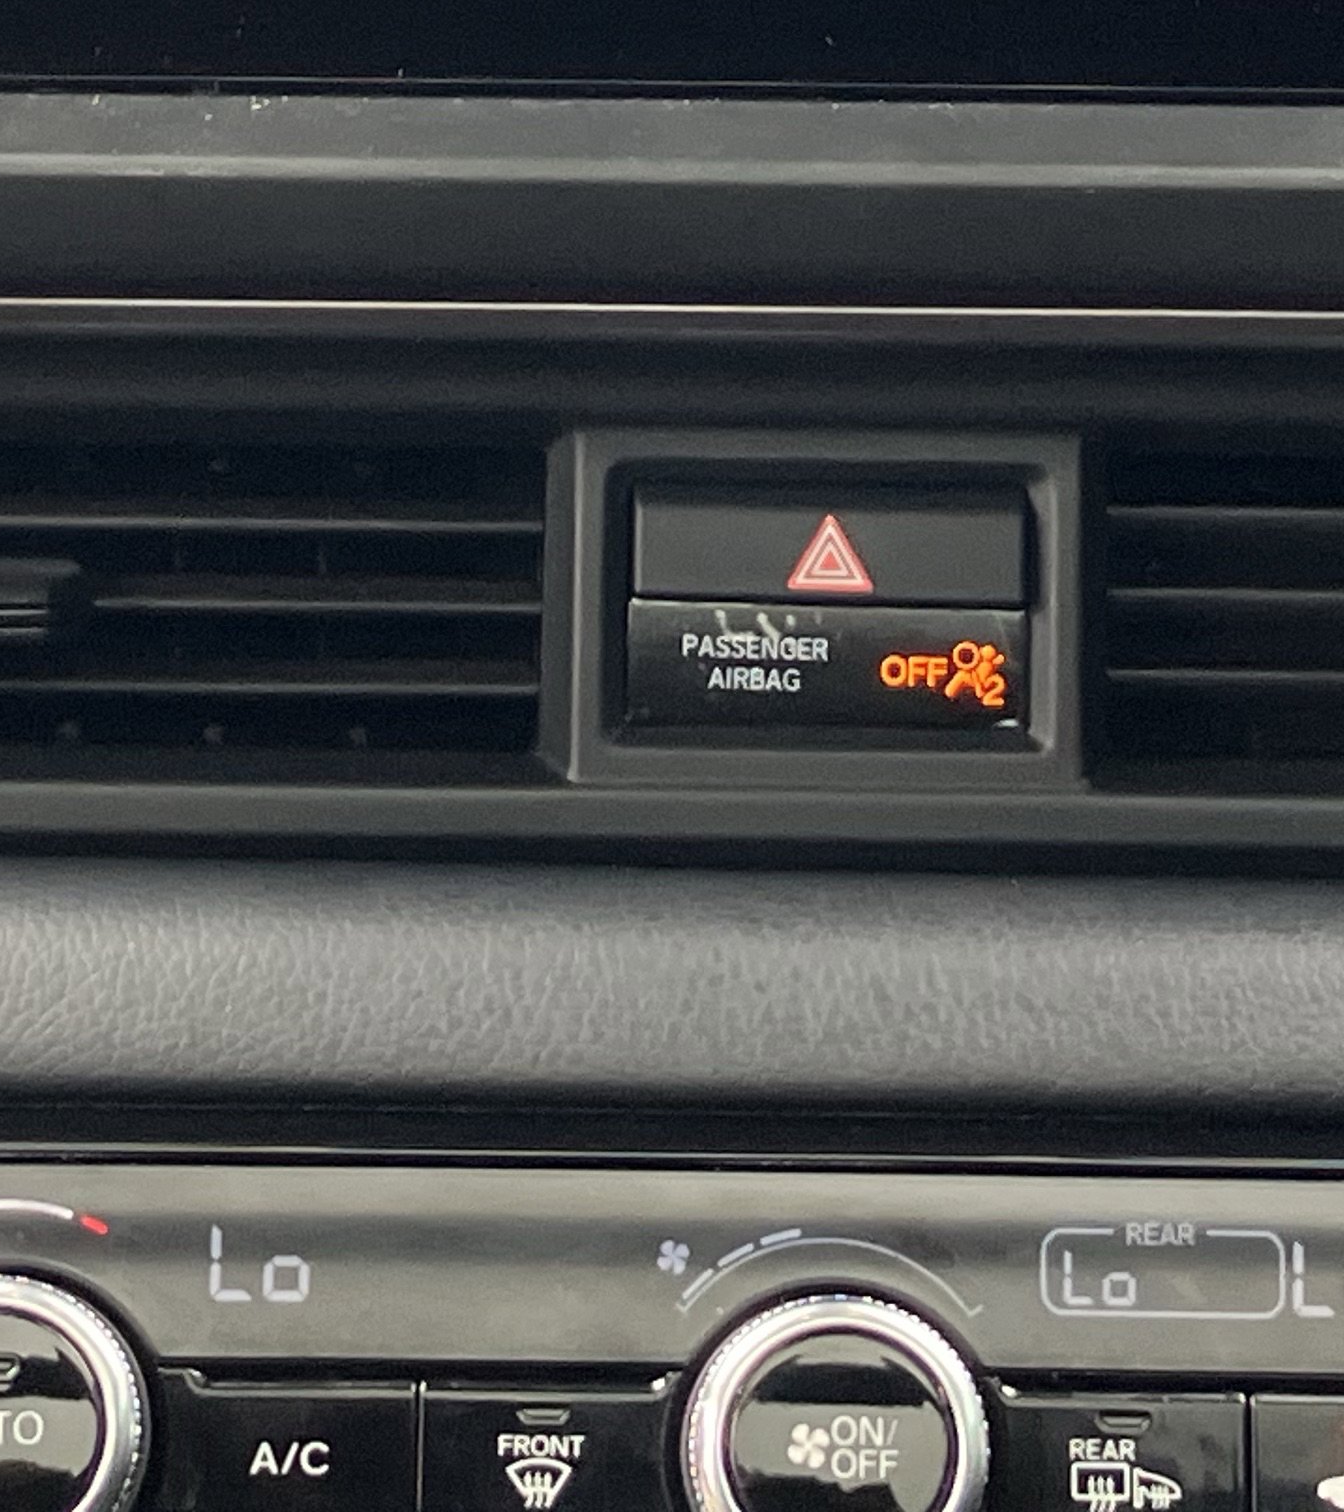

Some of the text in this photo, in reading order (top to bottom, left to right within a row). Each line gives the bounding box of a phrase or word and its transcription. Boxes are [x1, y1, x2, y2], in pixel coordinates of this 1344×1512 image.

[680, 634, 830, 663] PASSENGER
[706, 667, 803, 692] AIRBAG
[879, 655, 948, 688] OFF
[1123, 1219, 1199, 1247] REAR
[207, 1220, 314, 1304] Lo
[1060, 1248, 1140, 1308] Lo
[495, 1431, 587, 1459] FRONT
[828, 1414, 901, 1447] ON/
[248, 1439, 332, 1478] A/C
[828, 1448, 901, 1482] OFF
[1067, 1436, 1138, 1463] REAR
